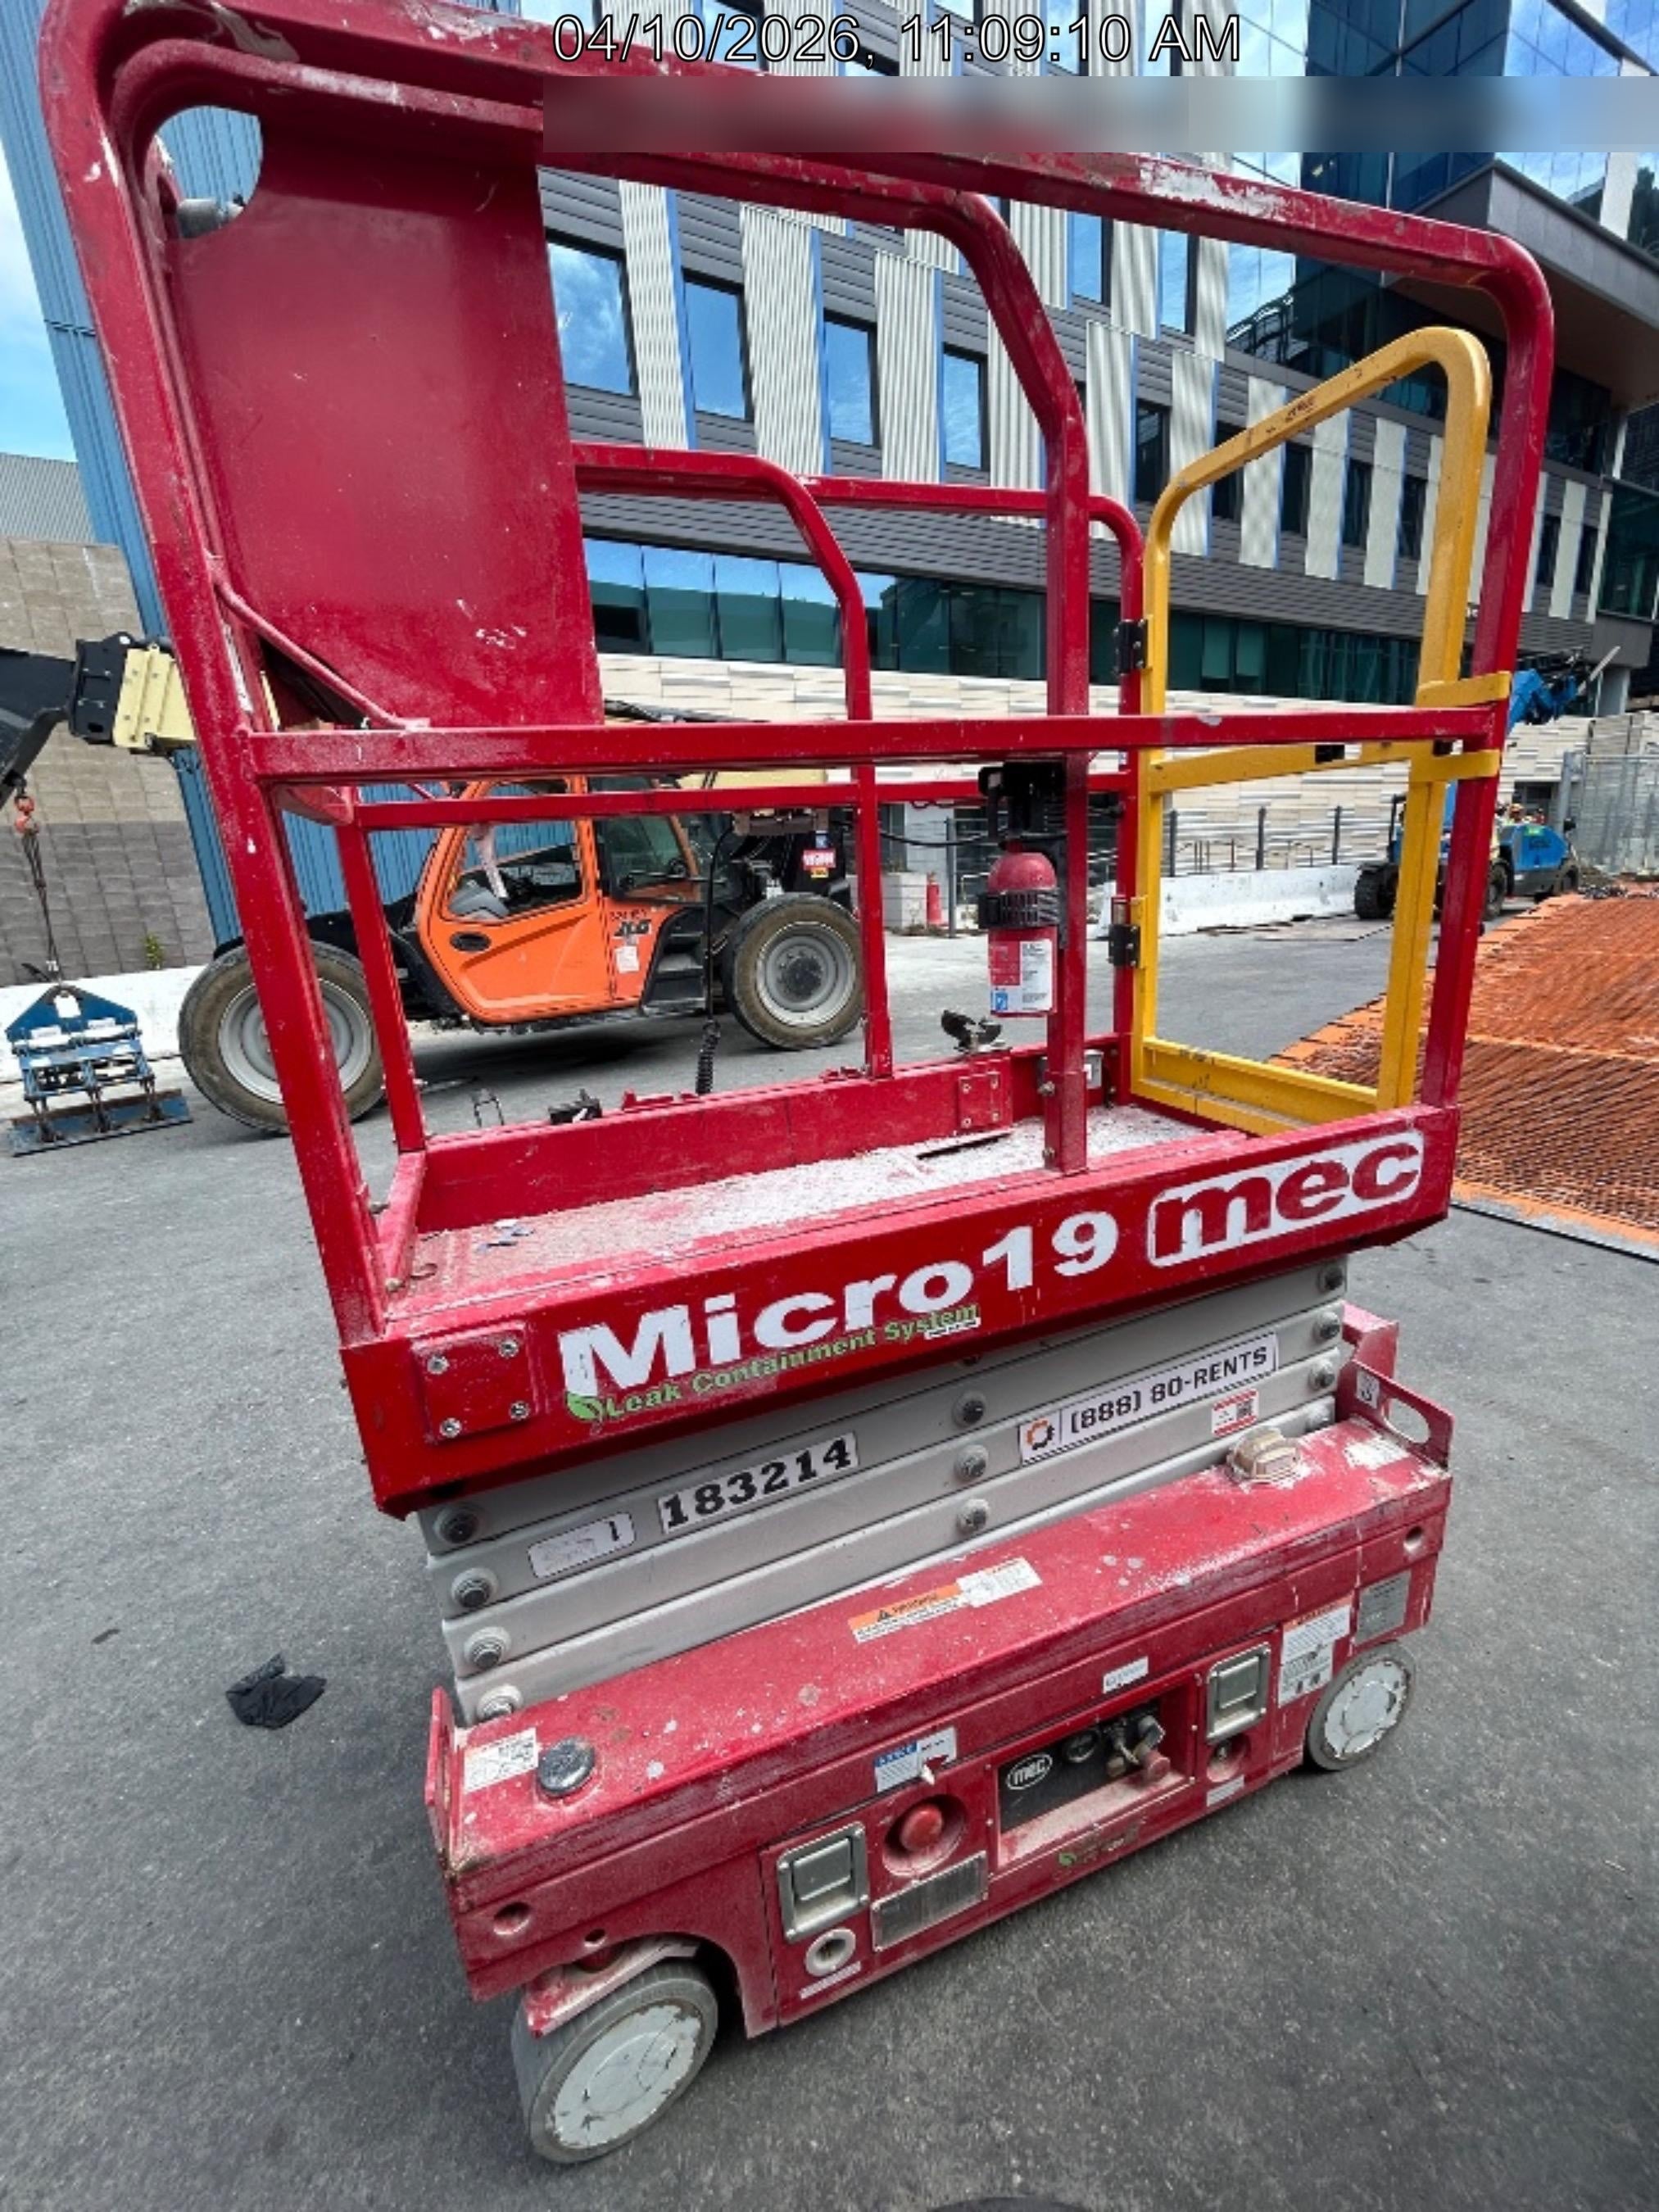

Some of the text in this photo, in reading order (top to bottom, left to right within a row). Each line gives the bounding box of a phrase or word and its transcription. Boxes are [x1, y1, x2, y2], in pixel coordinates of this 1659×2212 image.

[608, 1385, 683, 1421] Leak
[691, 1329, 877, 1394] Containment
[884, 1303, 980, 1344] System
[1151, 1345, 1267, 1403] 80-RENTS
[662, 1435, 852, 1529] 183214
